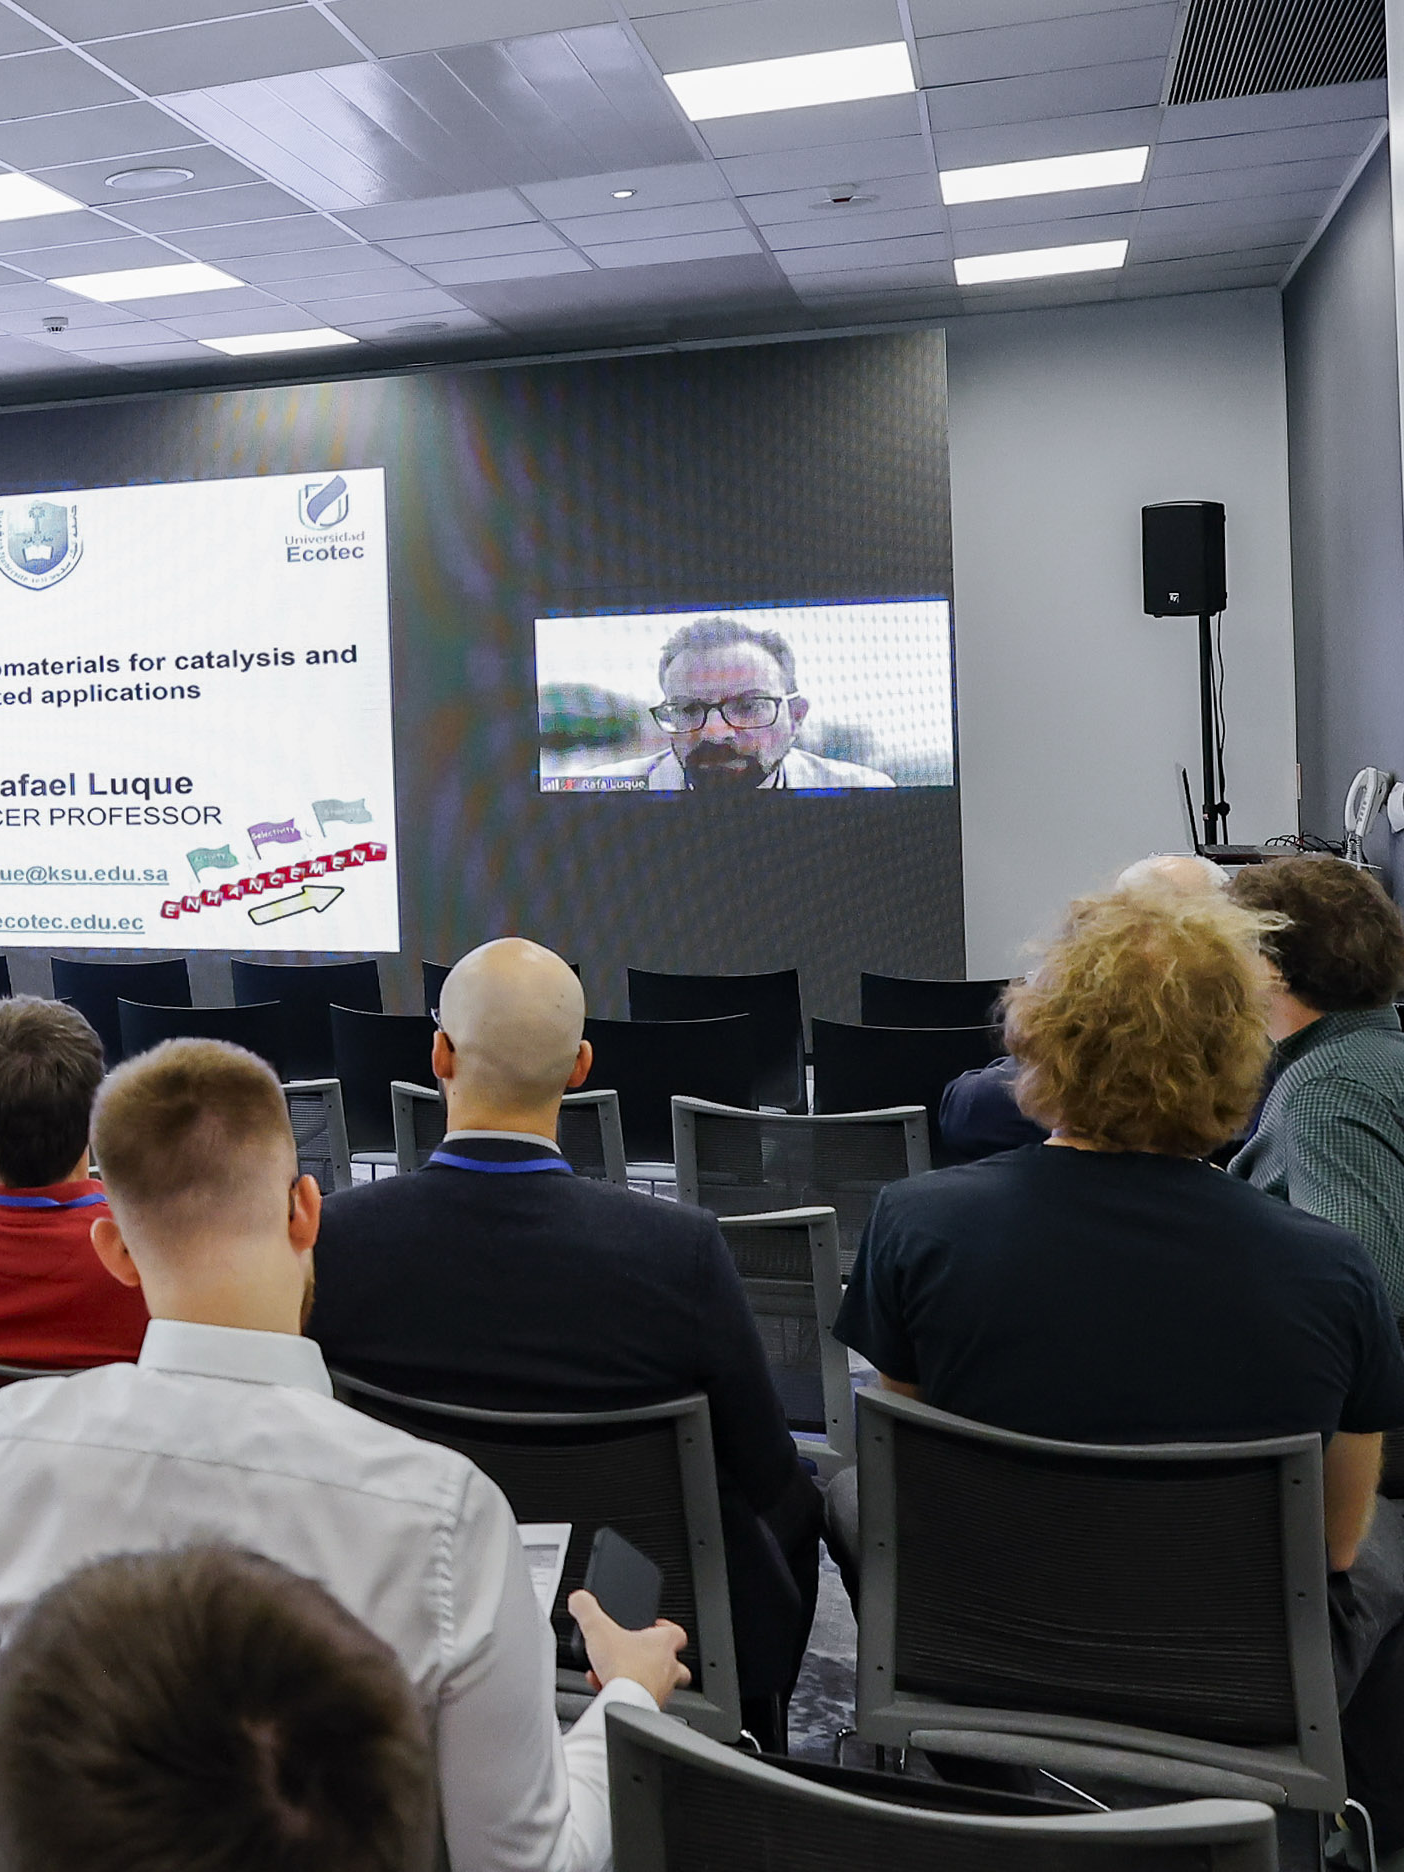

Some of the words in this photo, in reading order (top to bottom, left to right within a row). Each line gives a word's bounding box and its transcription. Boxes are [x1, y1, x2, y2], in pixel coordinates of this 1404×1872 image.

[285, 531, 365, 545] Universidad
[286, 544, 365, 563] Ecotec
[128, 653, 167, 673] for
[174, 647, 296, 674] catalysis
[305, 644, 358, 666] and
[41, 682, 201, 708] applications
[88, 772, 195, 800] Luque
[610, 778, 646, 791] Luque
[48, 806, 223, 826] PROFESSOR
[164, 843, 385, 918] ENHANCEMENT
